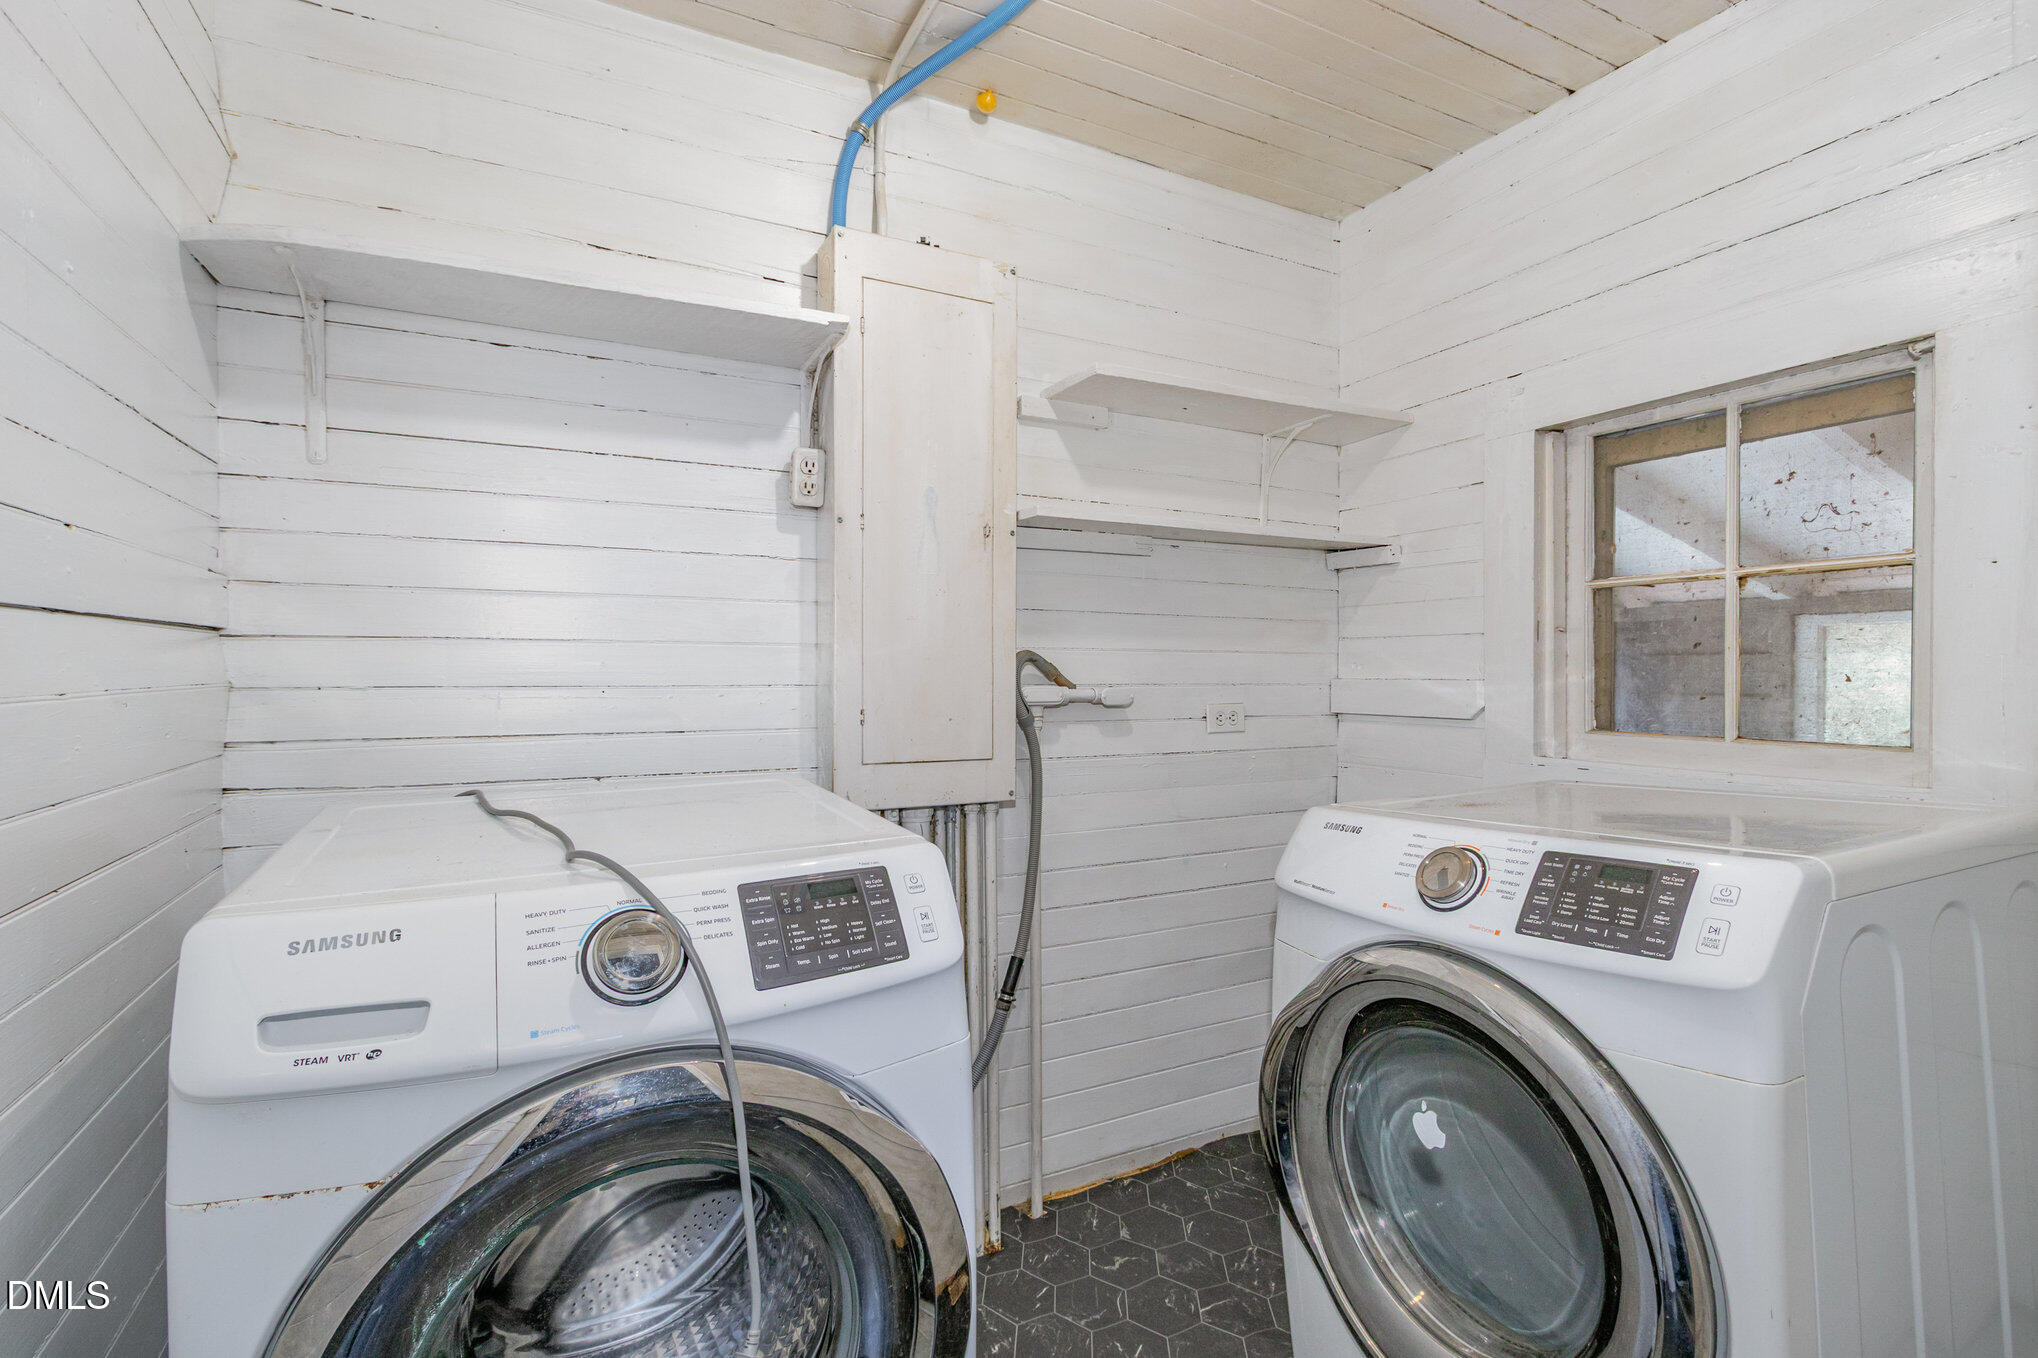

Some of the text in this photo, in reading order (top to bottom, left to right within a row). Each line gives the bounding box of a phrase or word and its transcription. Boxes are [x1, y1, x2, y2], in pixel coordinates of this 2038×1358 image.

[1323, 822, 1363, 834] SAMSUNG
[617, 898, 642, 906] NORMAL
[525, 911, 547, 919] HEAVY
[526, 927, 556, 936] SANITIZE
[703, 931, 733, 940] DELICATES
[287, 928, 402, 956] SAMSUNG
[527, 941, 561, 951] ALLERGEN
[527, 959, 547, 967] RINSE
[293, 1056, 329, 1067] STEAM
